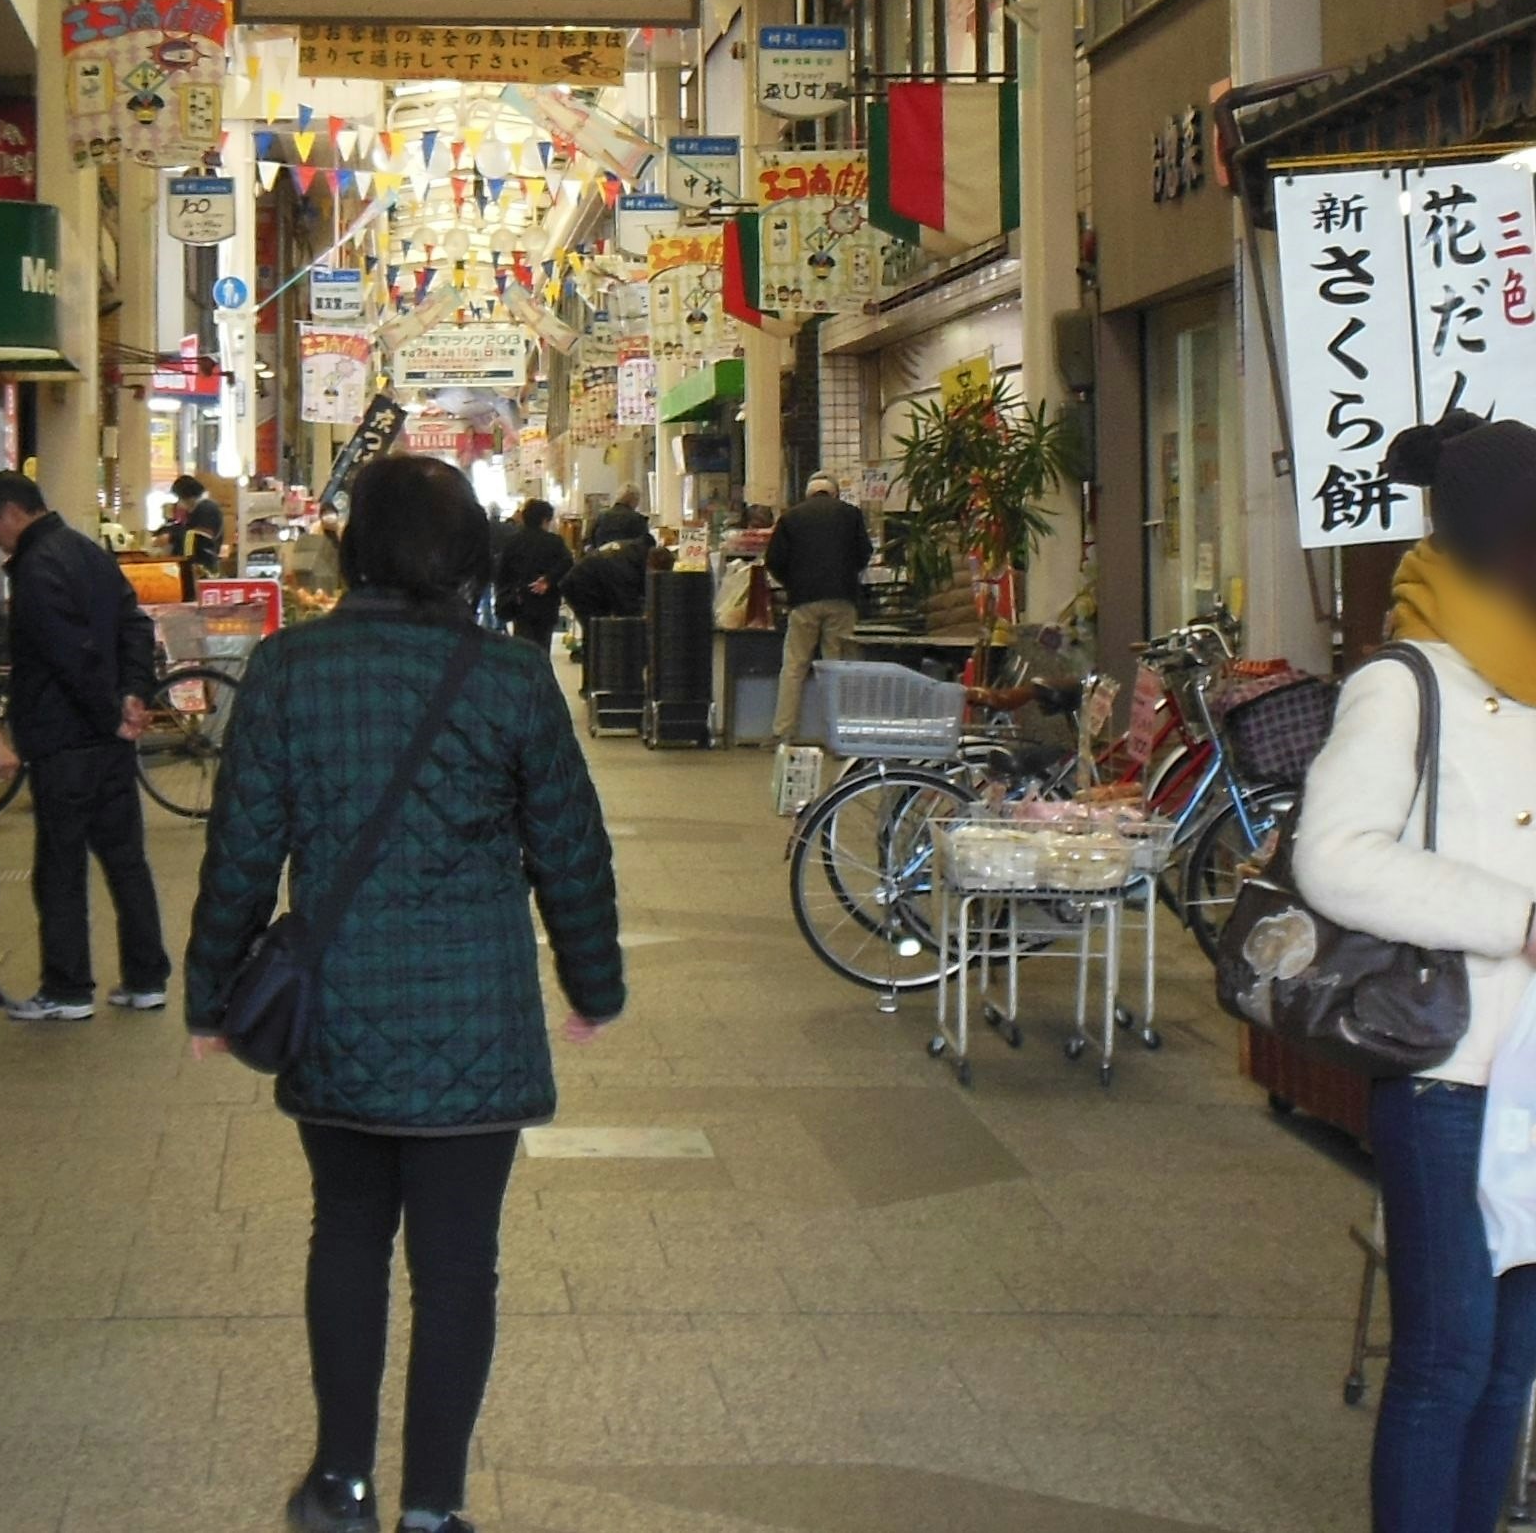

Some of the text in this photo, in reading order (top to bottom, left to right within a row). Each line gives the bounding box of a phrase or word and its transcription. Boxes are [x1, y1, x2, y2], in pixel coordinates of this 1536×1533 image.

[1310, 190, 1409, 533] 新さくら餅
[1493, 210, 1535, 326] 三色
